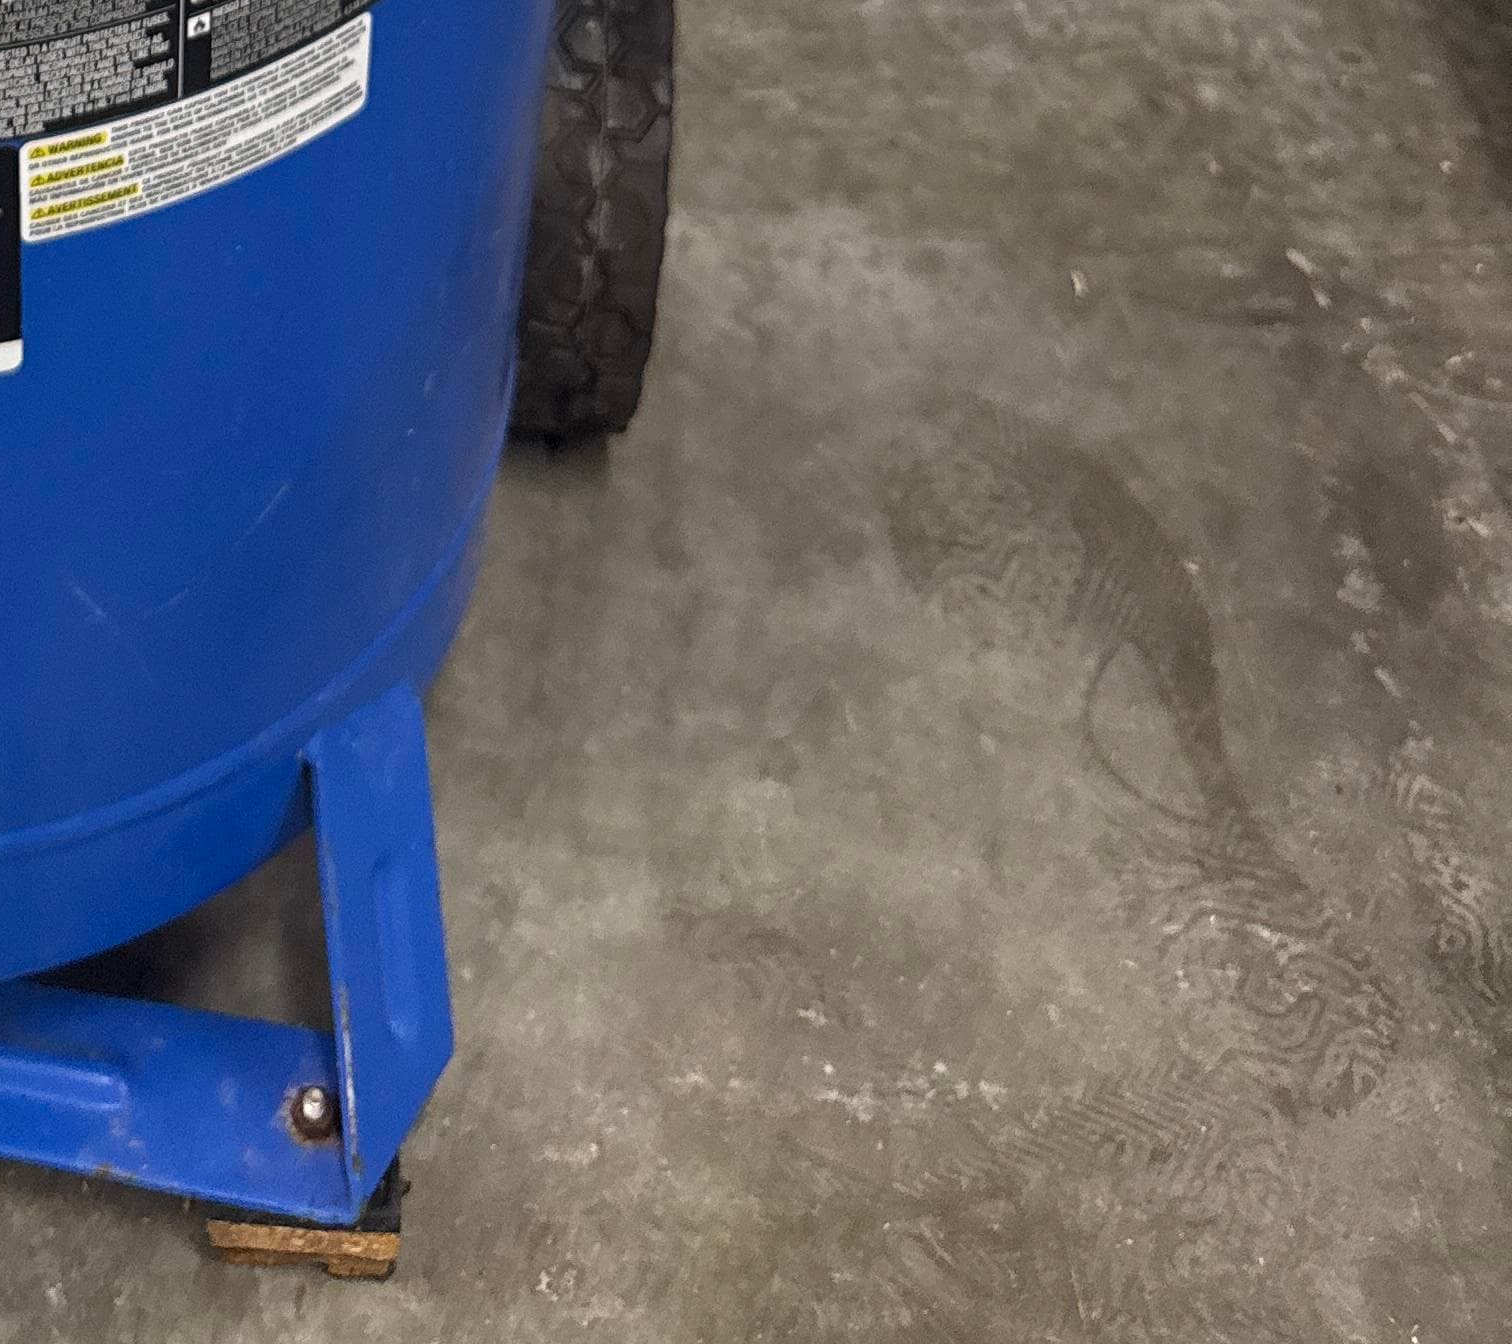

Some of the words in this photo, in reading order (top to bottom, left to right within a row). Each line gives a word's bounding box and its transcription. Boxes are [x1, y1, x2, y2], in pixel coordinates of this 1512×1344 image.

[48, 132, 103, 154] WARNING
[46, 155, 125, 182] ADVERTENCIA
[46, 183, 139, 216] AVERTISSEMENT
